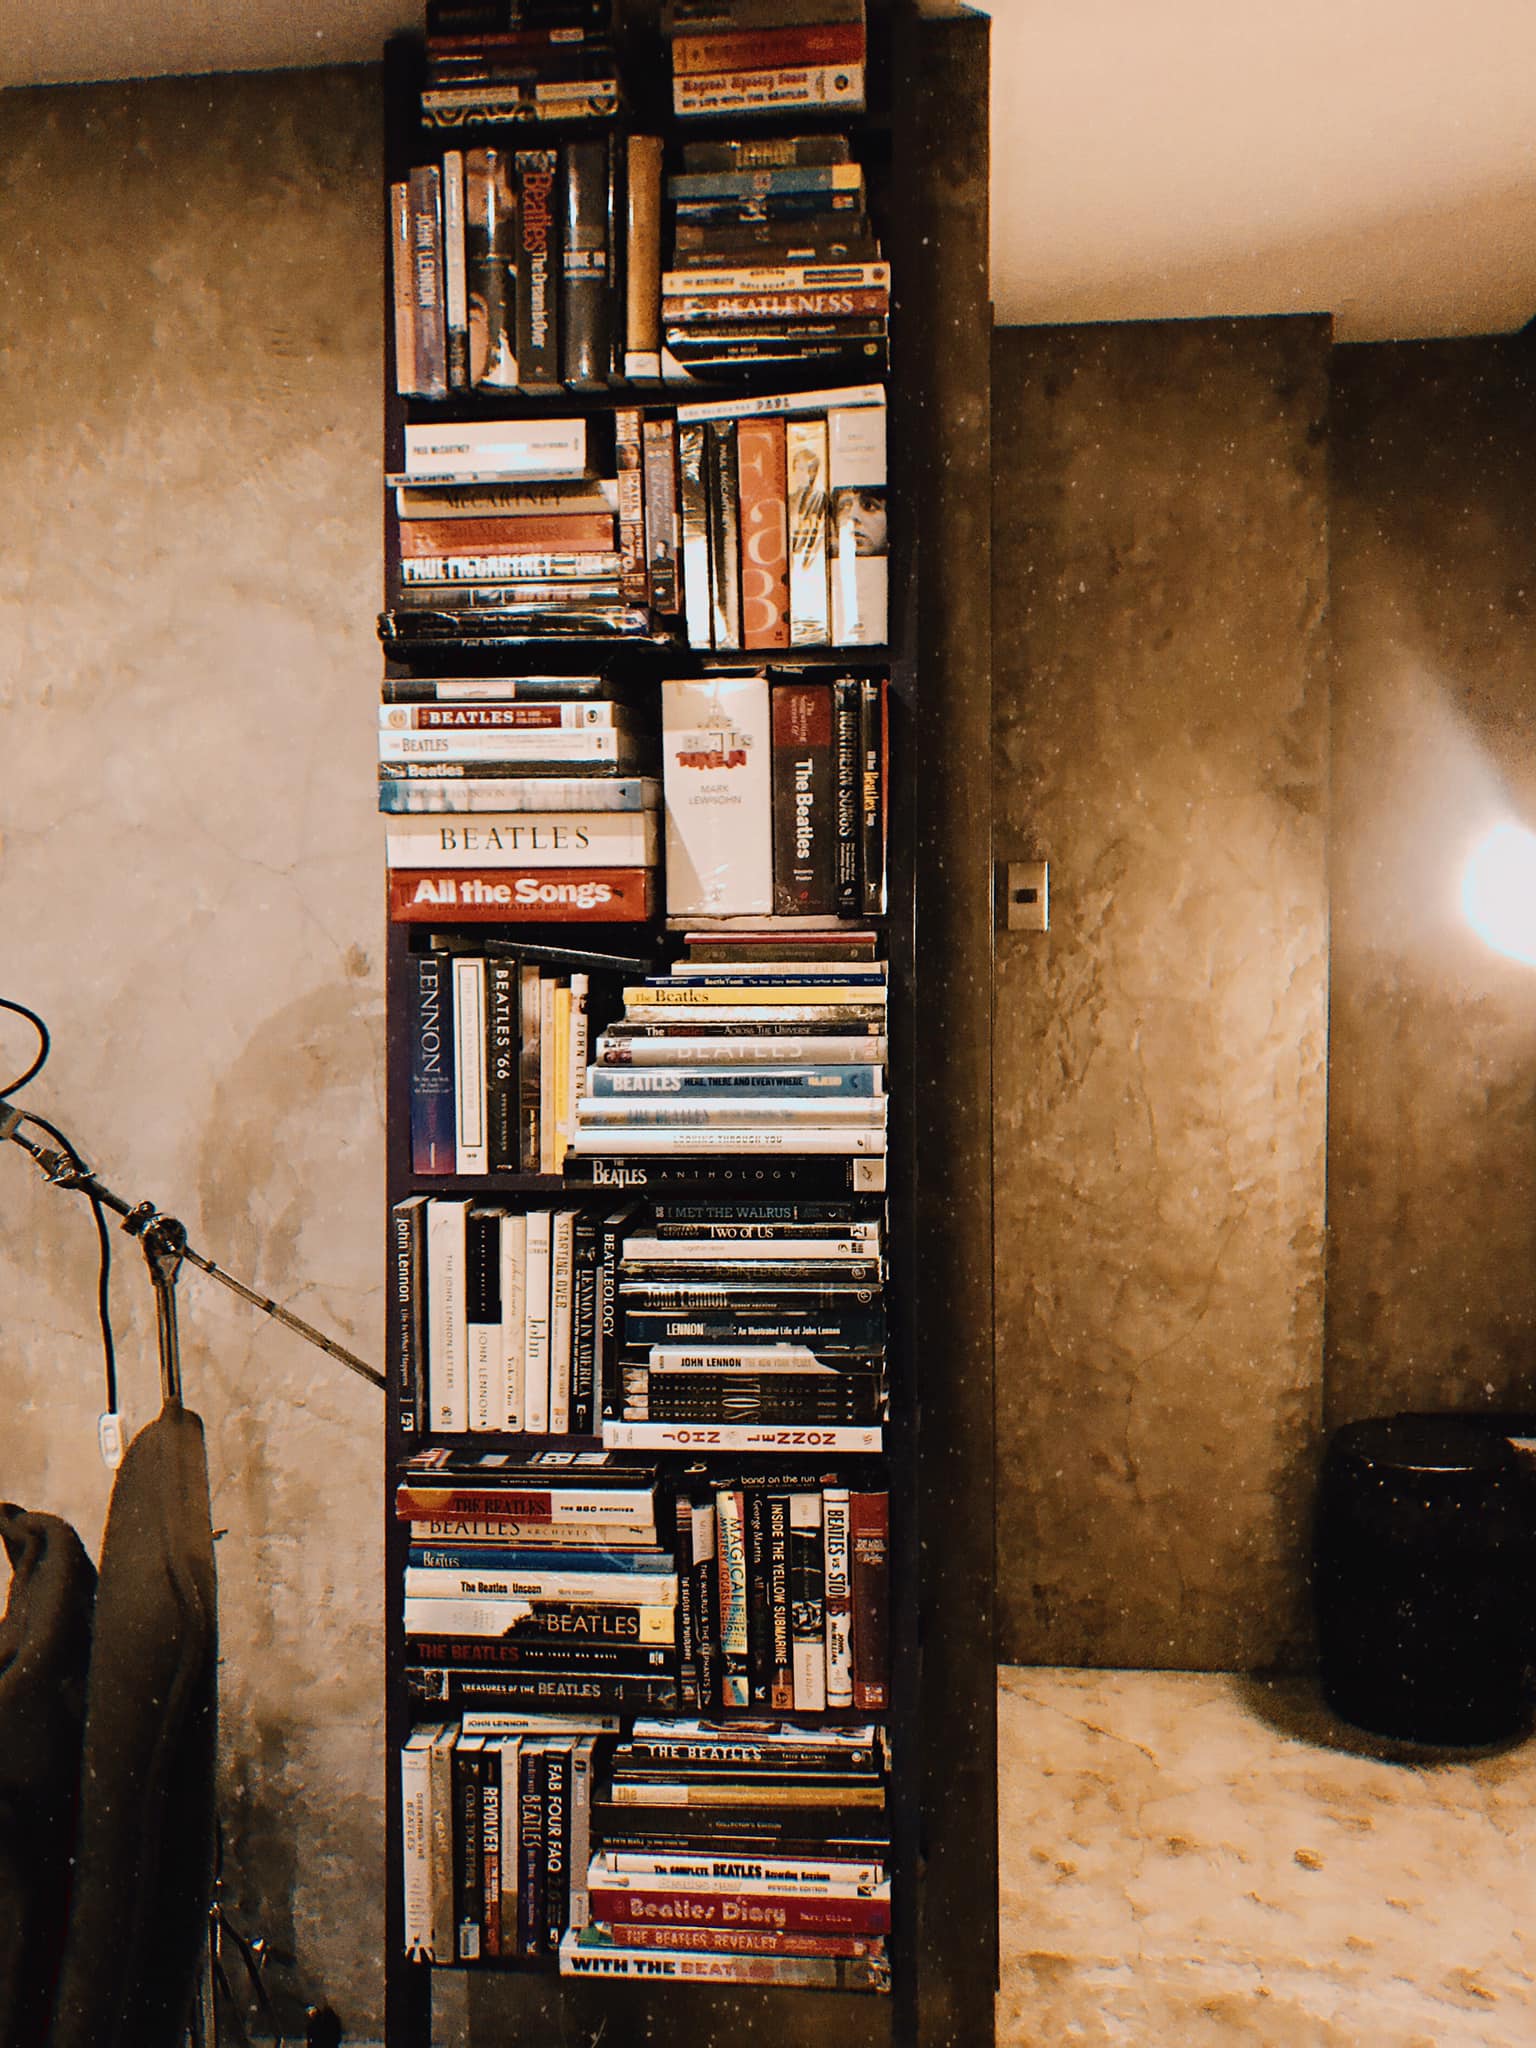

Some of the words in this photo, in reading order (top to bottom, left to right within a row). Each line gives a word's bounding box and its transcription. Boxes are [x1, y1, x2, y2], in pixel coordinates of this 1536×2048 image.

[523, 171, 553, 252] Beatles
[416, 251, 437, 309] LENNON
[718, 292, 855, 318] BEATLENESS
[428, 710, 515, 725] BEATLES
[402, 738, 449, 753] BEATLES
[839, 710, 858, 785] NORTHERN
[794, 758, 814, 791] The
[862, 771, 880, 811] Beatles
[796, 792, 814, 859] Beatles
[838, 789, 858, 837] SONGS
[439, 826, 591, 850] BEATLES
[413, 879, 458, 904] All
[460, 879, 511, 904] the
[514, 878, 613, 909] Songs
[496, 969, 510, 1047] BEATLES
[655, 988, 710, 1004] Beatles
[419, 960, 441, 1074] LENNON
[645, 1026, 666, 1037] The
[575, 1021, 587, 1057] JOHN
[612, 1076, 682, 1093] BEATLES
[717, 1135, 762, 1144] THROUGH
[764, 1135, 783, 1144] YOU
[592, 1159, 648, 1189] BEATLES
[660, 1169, 801, 1180] ANTHOLOGY
[674, 1207, 702, 1218] MET
[704, 1207, 733, 1218] THE
[736, 1207, 791, 1218] WALRUS
[397, 1218, 411, 1250] John
[710, 1226, 738, 1238] Two
[739, 1225, 754, 1238] of
[756, 1225, 775, 1238] Us
[555, 1222, 569, 1276] STARTING
[398, 1253, 412, 1303] Lennon
[444, 1275, 454, 1301] JOHN
[579, 1269, 595, 1319] LENNON
[603, 1233, 616, 1338] BEATLEOLOGY
[555, 1280, 568, 1309] OVER
[445, 1305, 454, 1346] LENNON
[527, 1314, 547, 1359] John
[579, 1323, 594, 1337] IN
[666, 1322, 704, 1337] LENNON
[478, 1331, 488, 1363] JOHN
[681, 1356, 704, 1368] JOHN
[706, 1356, 742, 1368] LENNON
[578, 1342, 594, 1397] AMERICA
[479, 1366, 488, 1418] LENNON
[662, 1431, 721, 1444] JOHN
[747, 1431, 837, 1445] LENNON
[741, 1475, 766, 1486] band
[767, 1475, 781, 1485] on
[782, 1474, 799, 1485] the
[800, 1475, 816, 1485] run
[575, 1505, 597, 1513] BBC
[751, 1499, 764, 1530] George
[771, 1504, 784, 1537] INSIDE
[430, 1520, 521, 1536] BEATLES
[719, 1516, 731, 1562] MYSTERY
[827, 1509, 846, 1556] BEATLES
[730, 1518, 746, 1601] MAGICAL
[752, 1531, 763, 1563] Martin
[773, 1541, 784, 1560] THE
[460, 1581, 476, 1593] The
[478, 1582, 508, 1594] Beatles
[512, 1583, 542, 1595] Unseen
[700, 1564, 708, 1580] THE
[719, 1566, 732, 1600] TOURS
[773, 1563, 785, 1602] YELLOW
[700, 1582, 709, 1613] WALRUS
[546, 1613, 638, 1635] BEATLES
[701, 1625, 709, 1640] THE
[774, 1606, 787, 1663] SUBMARINE
[419, 1645, 448, 1659] THE
[450, 1646, 520, 1662] BEATLES
[702, 1642, 711, 1686] ELEPHANTS
[461, 1683, 506, 1694] TREASURES
[508, 1685, 520, 1694] OF
[520, 1685, 535, 1695] THE
[537, 1683, 601, 1698] BEATLES
[649, 1745, 685, 1758] THE
[687, 1746, 763, 1761] BEATLES
[547, 1764, 562, 1791] FAB
[464, 1784, 478, 1817] COME
[547, 1795, 562, 1836] FOUR
[406, 1801, 415, 1851] BEATLES
[482, 1787, 499, 1852] REVOLVER
[521, 1793, 543, 1848] BEATLES
[464, 1820, 479, 1889] TOGETHER
[546, 1840, 562, 1873] FAQ
[654, 1864, 668, 1874] The
[670, 1865, 710, 1877] COMPLETE
[712, 1863, 762, 1880] BEATLES
[629, 1896, 717, 1921] Beatles
[721, 1896, 787, 1928] Diary
[626, 1929, 649, 1945] THE
[654, 1932, 707, 1948] BEATLES
[713, 1935, 778, 1951] REVEALED
[570, 1956, 629, 1973] WITH
[632, 1958, 676, 1976] THE
